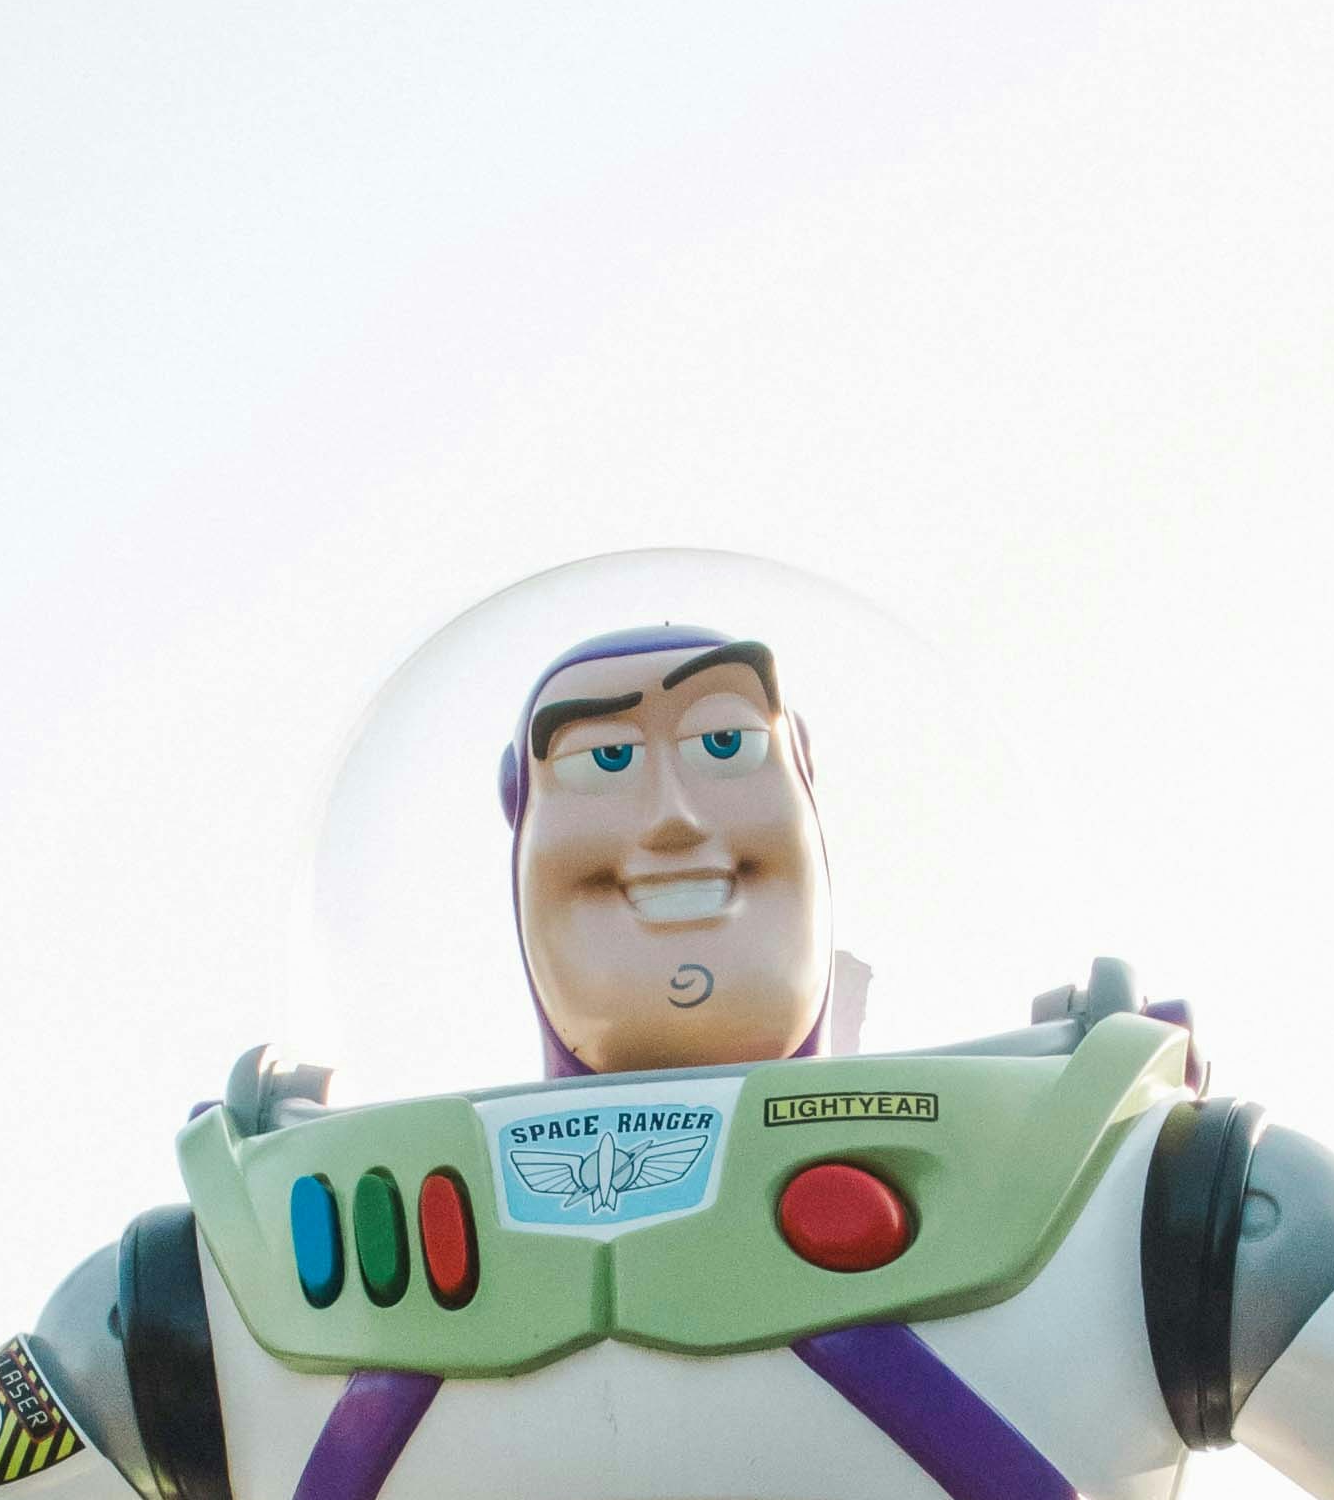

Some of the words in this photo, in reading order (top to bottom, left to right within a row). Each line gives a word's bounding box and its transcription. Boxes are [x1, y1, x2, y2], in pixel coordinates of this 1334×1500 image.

[772, 1096, 932, 1121] LIGHTYEAR
[510, 1114, 600, 1144] SPACE
[617, 1112, 714, 1133] RANGER
